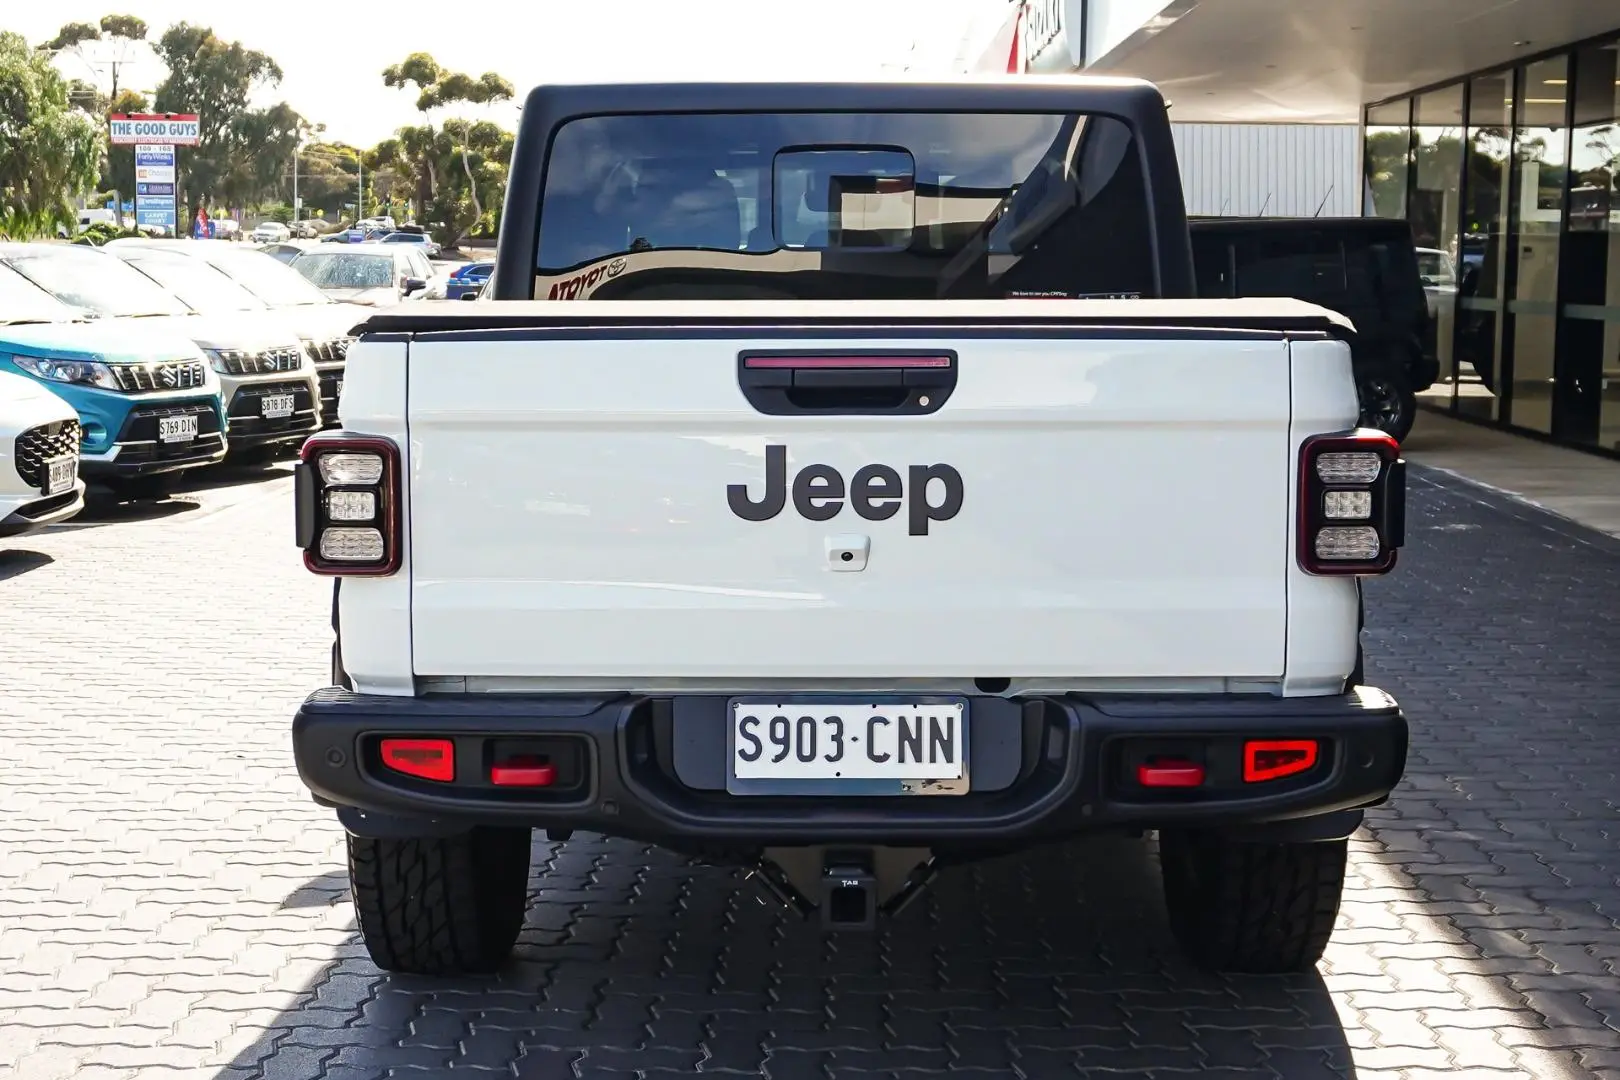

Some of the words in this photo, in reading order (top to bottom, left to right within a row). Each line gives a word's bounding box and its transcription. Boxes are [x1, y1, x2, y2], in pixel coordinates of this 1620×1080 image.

[112, 122, 131, 135] THE
[135, 122, 166, 136] GOOD
[169, 123, 197, 136] GUYS
[726, 444, 964, 536] Jeep
